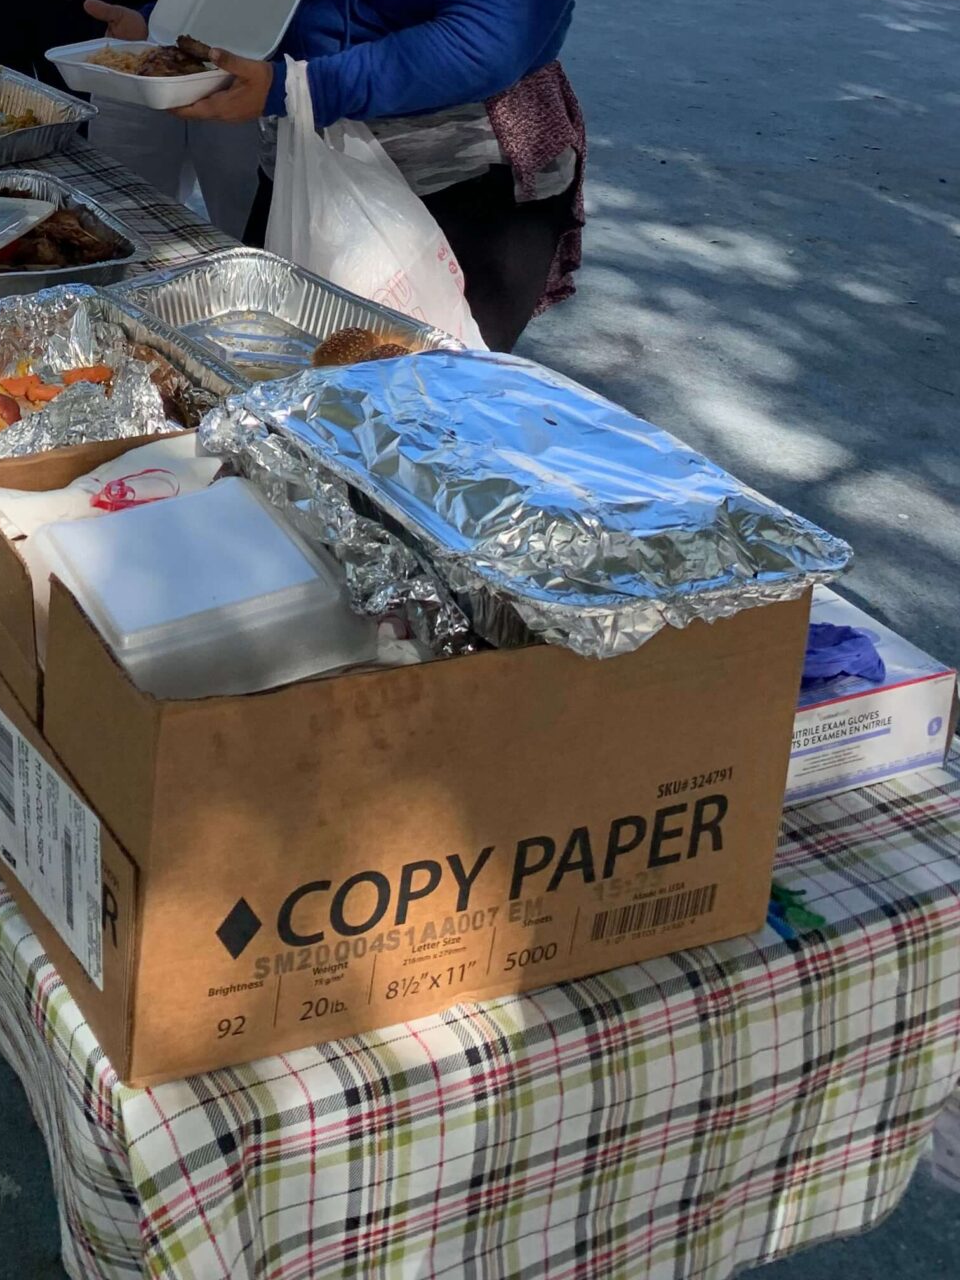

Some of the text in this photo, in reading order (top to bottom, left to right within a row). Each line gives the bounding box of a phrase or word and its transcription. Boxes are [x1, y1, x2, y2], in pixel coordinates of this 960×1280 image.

[803, 728, 847, 747] D'EXAMEN
[849, 726, 860, 735] EN
[862, 716, 893, 730] NITRILE
[822, 719, 846, 732] EXAM
[848, 710, 880, 726] GLOVES
[277, 794, 729, 947] COPY PAPER
[411, 936, 461, 954] Letter Size
[312, 961, 349, 976] Weight
[503, 942, 558, 972] 5000
[208, 980, 264, 997] Brightness
[217, 1015, 246, 1039] 92
